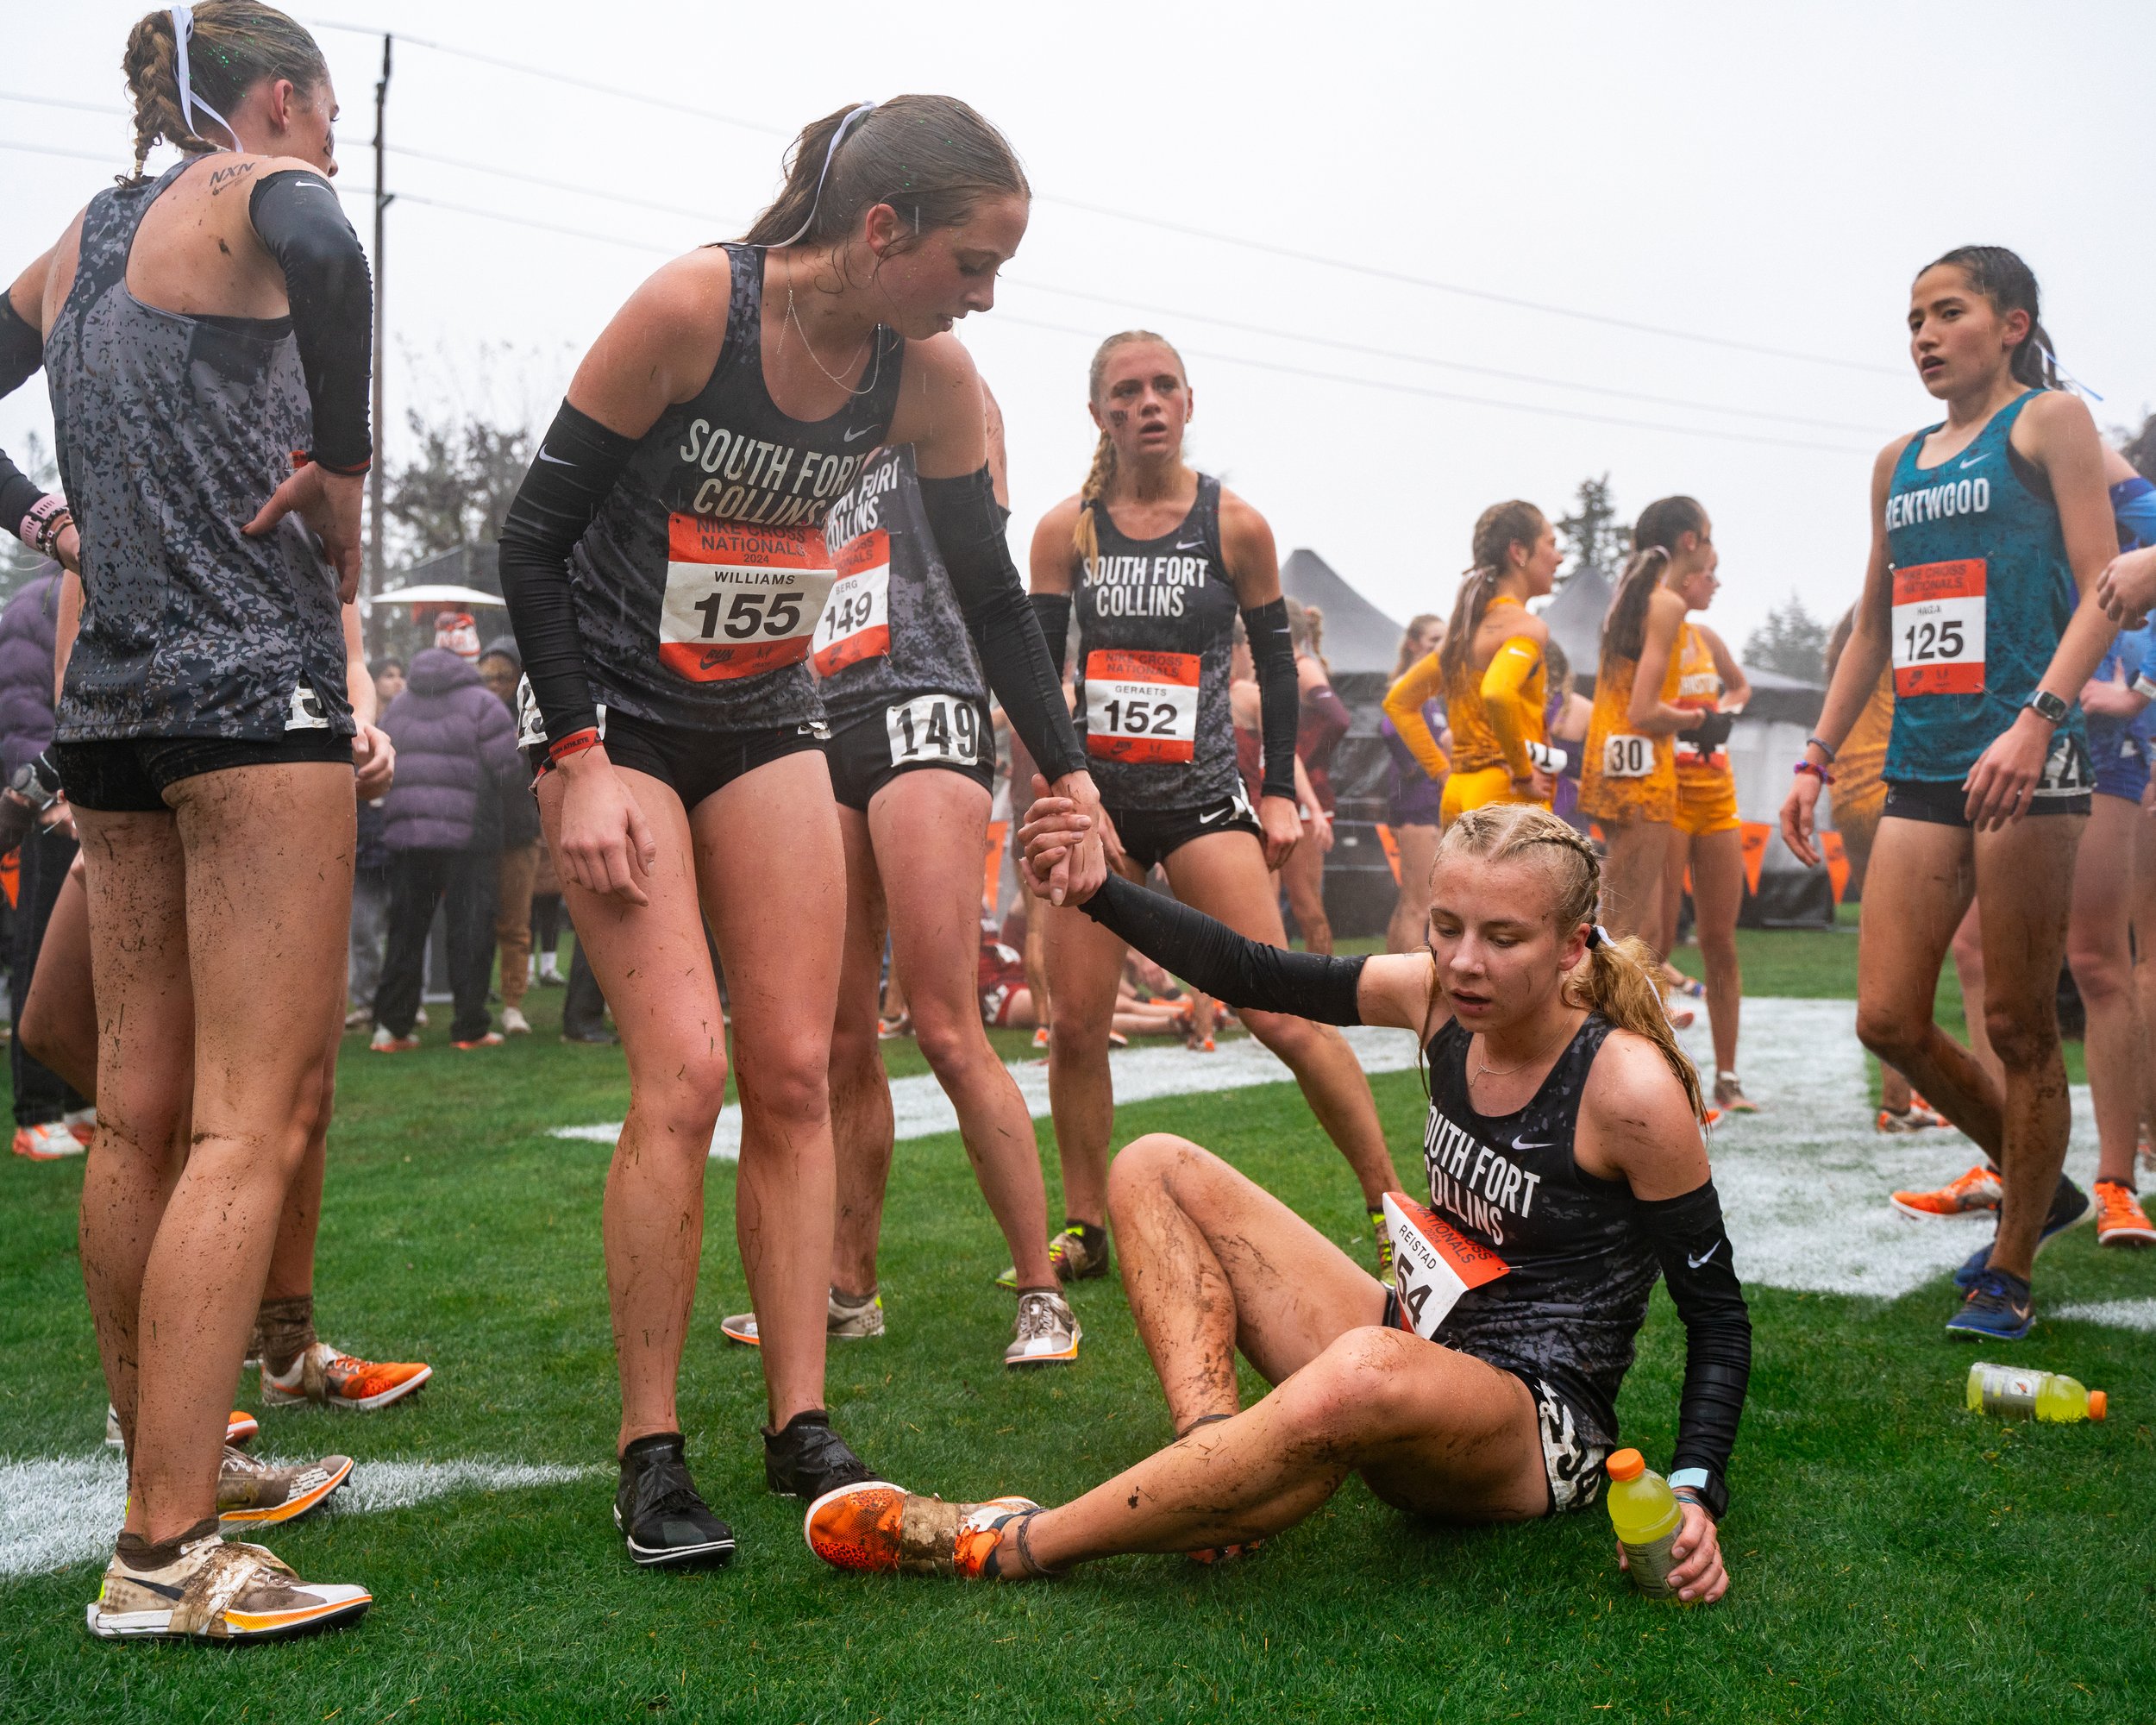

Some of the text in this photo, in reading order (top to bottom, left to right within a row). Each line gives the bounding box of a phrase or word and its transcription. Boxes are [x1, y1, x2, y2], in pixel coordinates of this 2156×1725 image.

[680, 418, 866, 498] SOUTH FORT
[693, 479, 826, 527] COLLINS
[697, 519, 805, 543] NIKE CROSS
[702, 536, 806, 557] NATIONALS
[743, 554, 769, 564] 2024
[1082, 555, 1208, 588] SOUTH FORT
[714, 571, 795, 586] WILLIAMS
[836, 580, 858, 595] BERG
[693, 592, 805, 639] 155
[825, 591, 872, 641] 149
[1096, 585, 1185, 618] COLLINS
[1905, 621, 1964, 661] 125
[1106, 653, 1182, 667] NIKE CROSS
[1106, 663, 1179, 677] NATIONALS
[1115, 685, 1167, 697] GERAETS
[897, 702, 976, 758] 149
[1104, 699, 1177, 735] 152
[1613, 739, 1642, 772] 30
[1425, 1101, 1540, 1218] OUTH FORT
[1399, 1224, 1437, 1270] REISTAD
[1424, 1228, 1442, 1245] 2024
